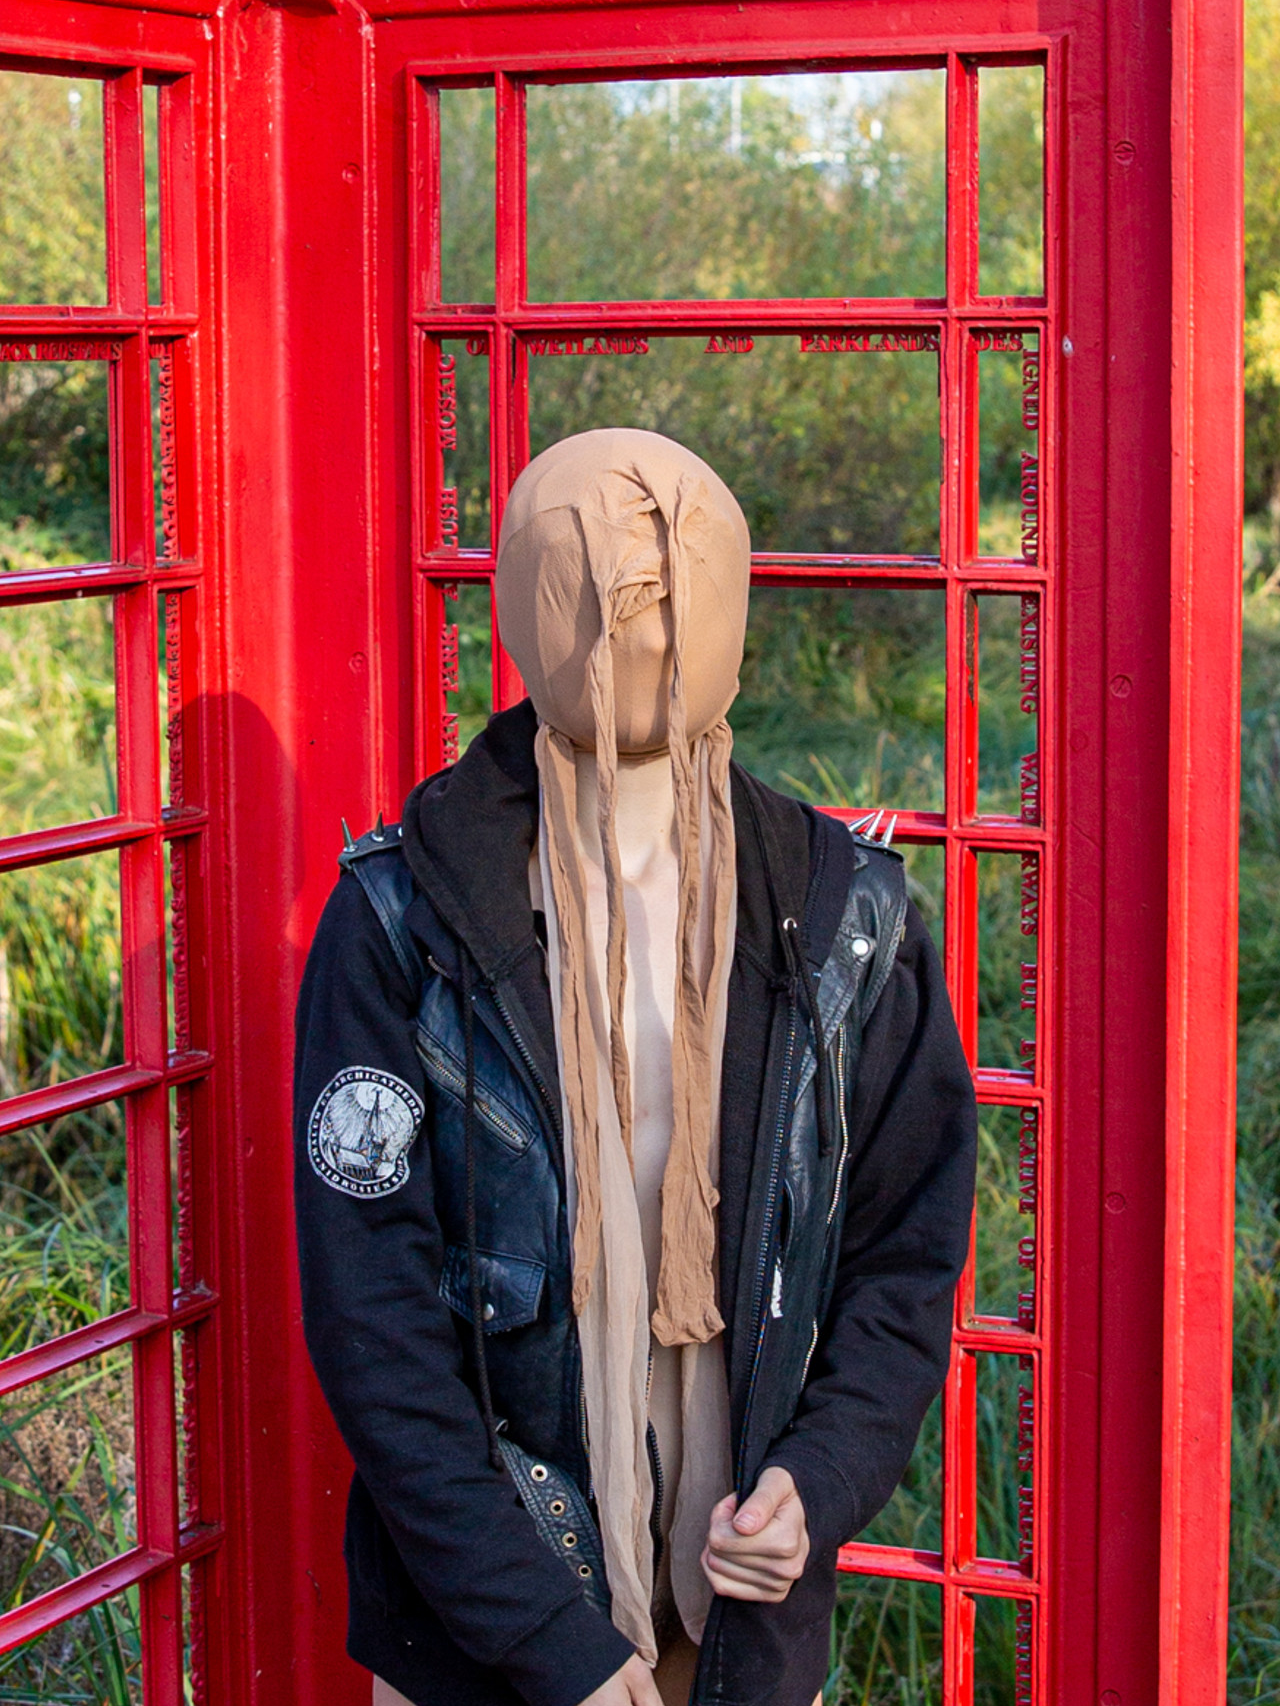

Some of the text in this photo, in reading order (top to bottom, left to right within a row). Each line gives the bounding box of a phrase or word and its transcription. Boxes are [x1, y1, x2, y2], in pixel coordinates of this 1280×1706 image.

[36, 341, 122, 360] REDSTARTS
[527, 336, 650, 356] WETLANDS
[704, 334, 754, 354] AND
[799, 332, 940, 353] PARKLANDS
[440, 353, 458, 451] MOSAIC
[441, 487, 459, 550] LUSH
[1021, 451, 1039, 565] AROUND
[441, 623, 459, 694] PARK
[1021, 595, 1039, 714] EXISTING
[1019, 962, 1038, 1015] BUT
[334, 1071, 421, 1125] ARCHICATHEDRA
[1018, 1236, 1036, 1271] OF
